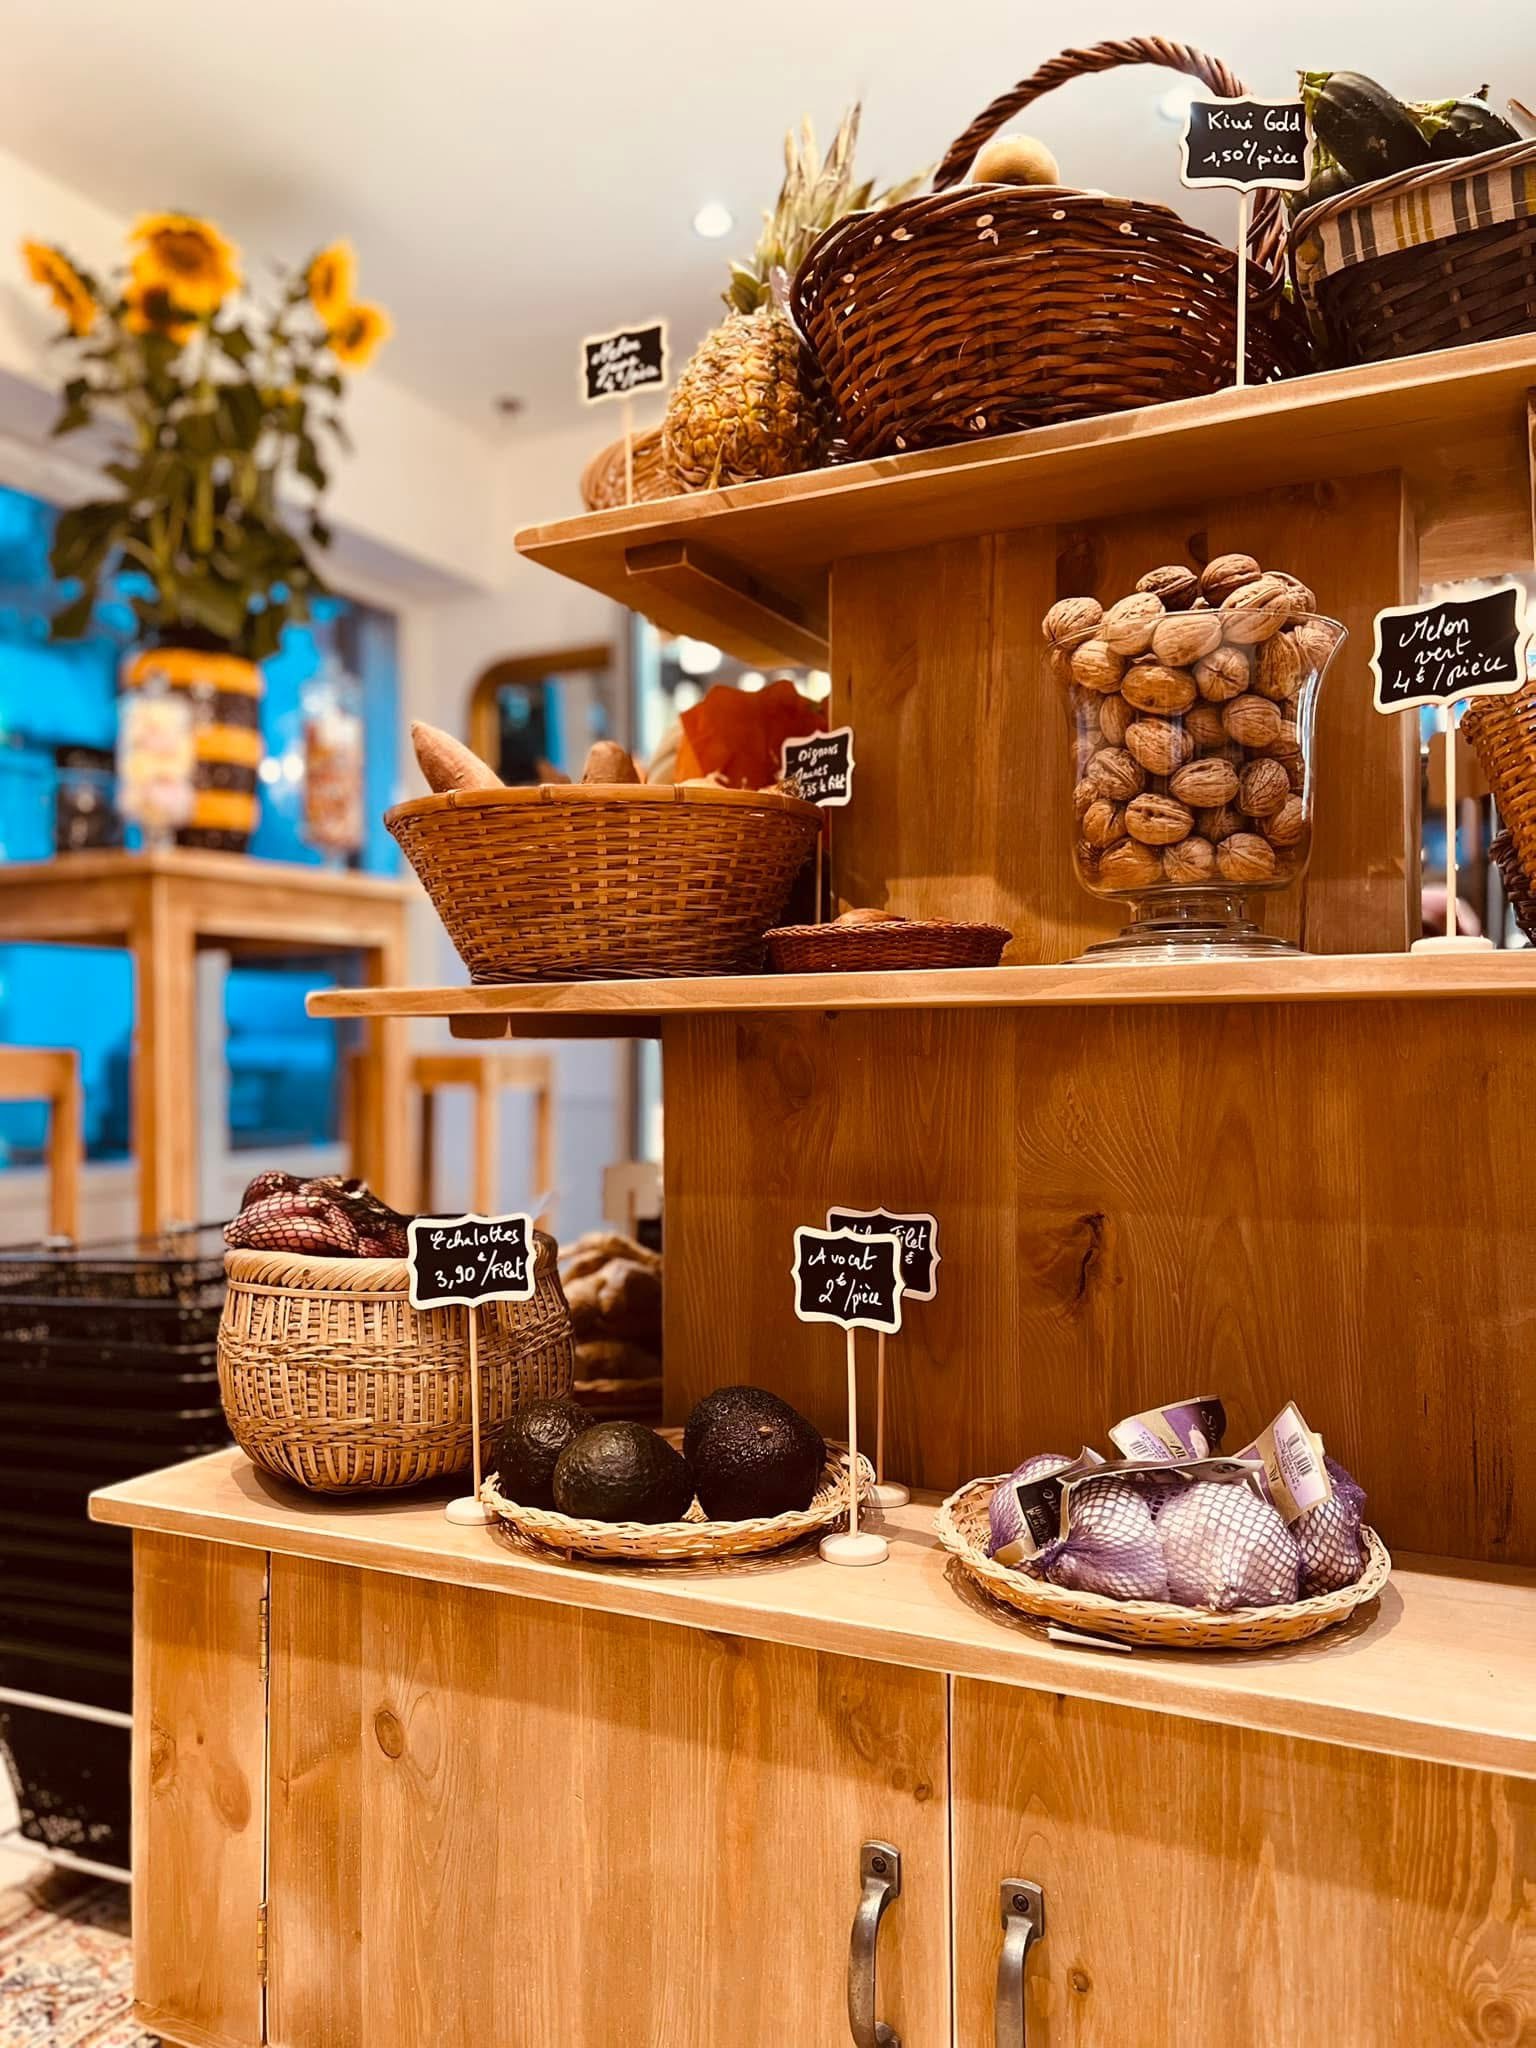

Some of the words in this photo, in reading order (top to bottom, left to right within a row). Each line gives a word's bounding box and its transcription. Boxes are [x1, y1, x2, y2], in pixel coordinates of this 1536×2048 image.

[1207, 110, 1254, 130] Kiwi
[1263, 109, 1301, 132] Gold
[1398, 613, 1469, 647] Melon
[1414, 636, 1472, 665] vert
[798, 743, 839, 767] Oignons
[808, 1245, 878, 1271] Avocat
